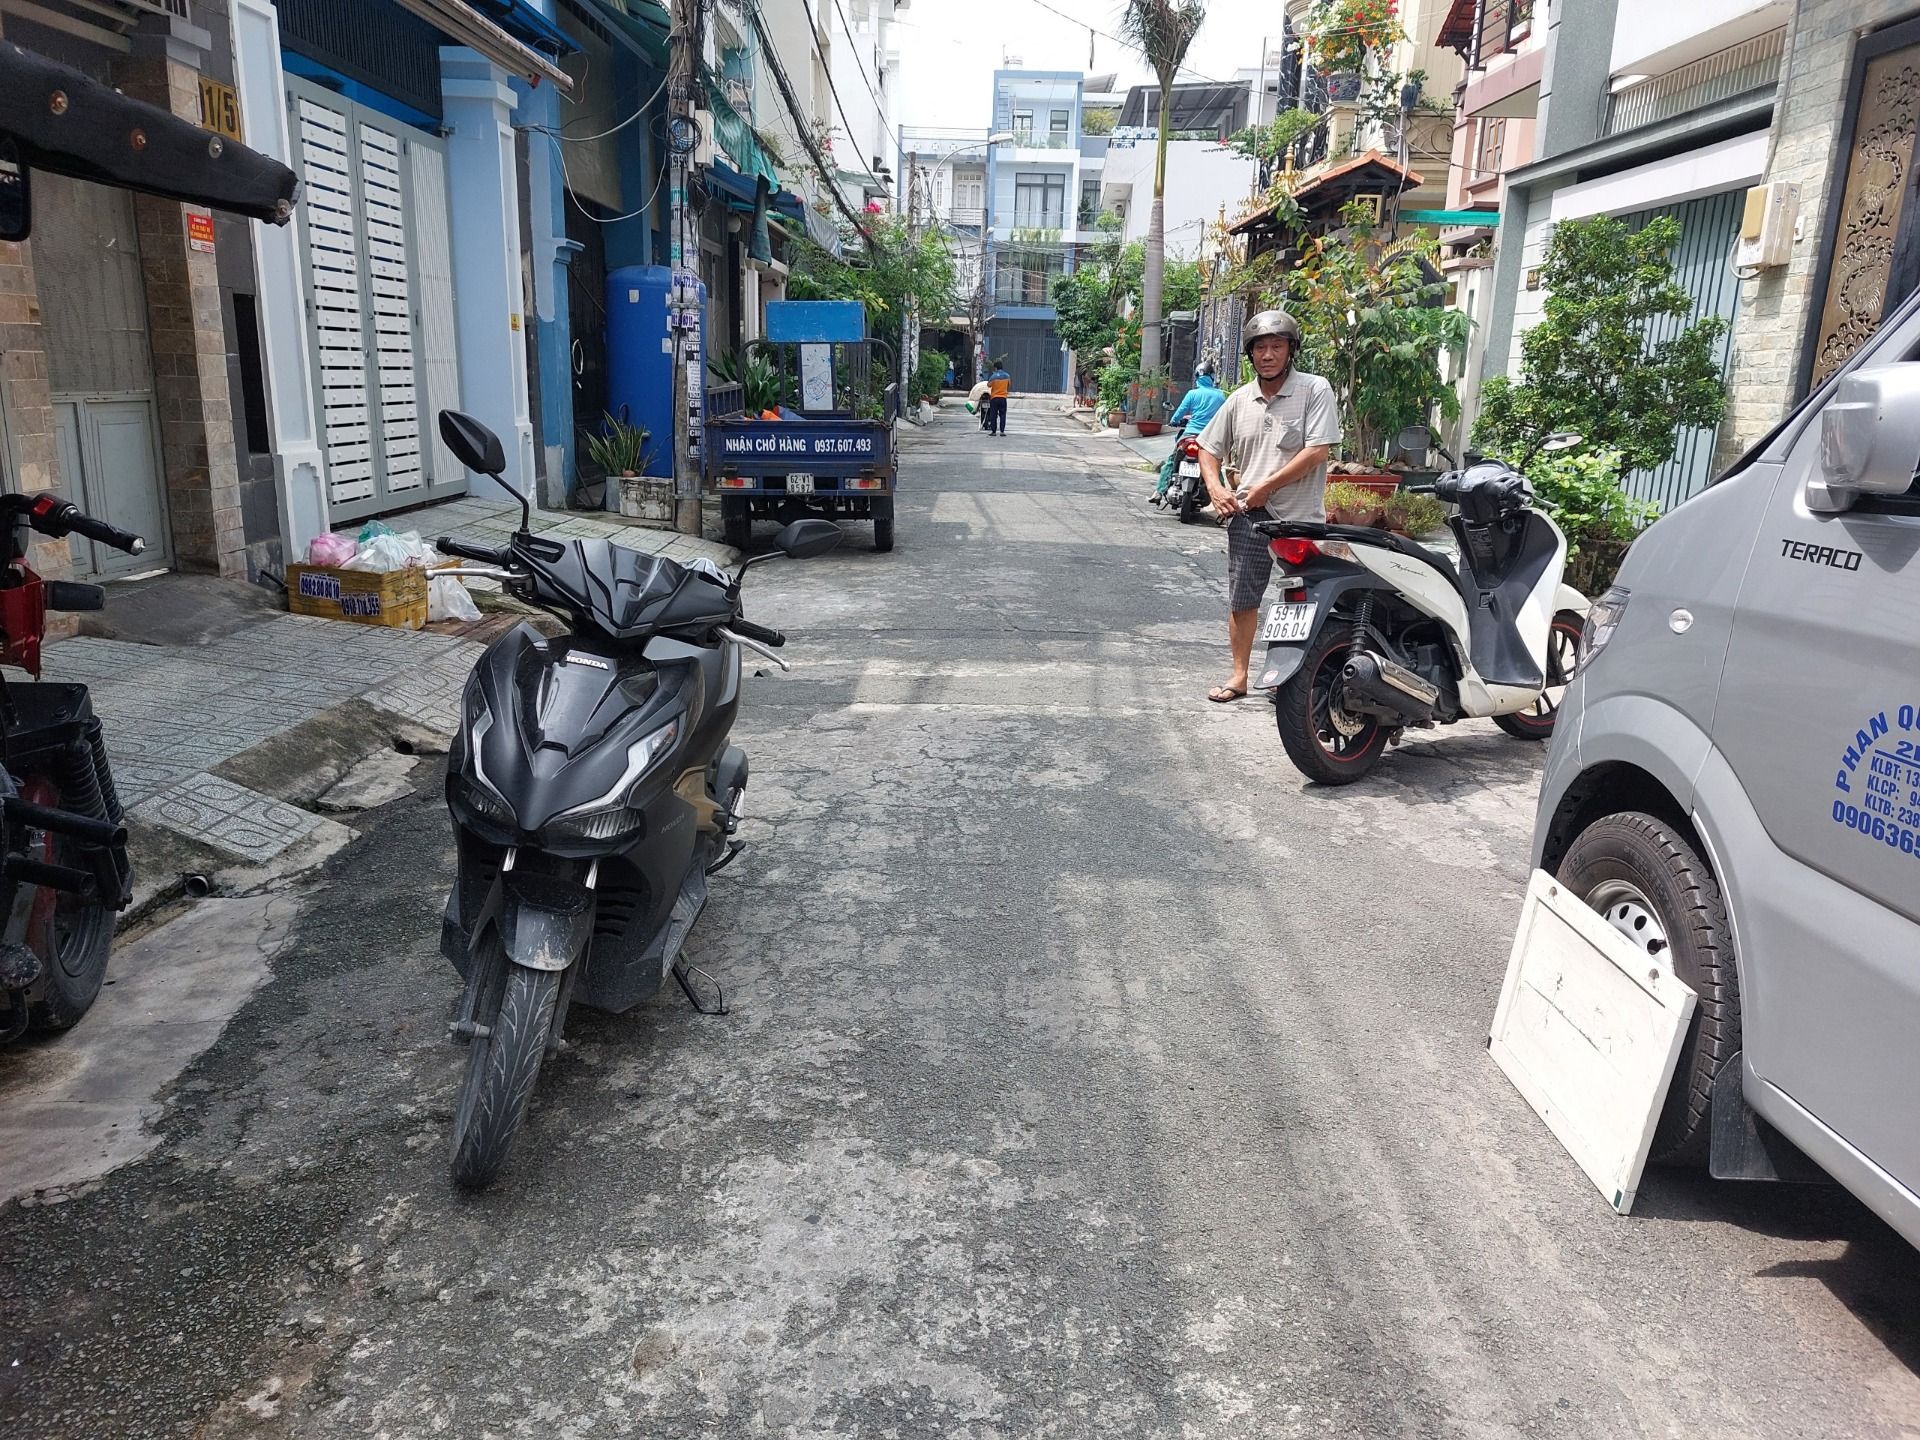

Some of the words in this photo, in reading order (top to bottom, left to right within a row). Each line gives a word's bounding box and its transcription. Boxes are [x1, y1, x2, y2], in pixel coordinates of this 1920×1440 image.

[725, 435, 753, 454] NHẬN
[755, 434, 776, 451] CHỞ
[779, 435, 807, 451] HÀNG
[814, 438, 872, 453] 0937.607.493
[1781, 539, 1863, 571] TERACO
[1273, 604, 1308, 621] 59-N1
[1264, 622, 1307, 639] 906.04
[566, 655, 609, 670] HONDA
[1835, 711, 1889, 794] PHAN
[1898, 704, 1920, 731] Q
[1870, 755, 1902, 781] KLBT:
[1866, 773, 1900, 801] KLCP:
[1864, 792, 1895, 818] KLTB:
